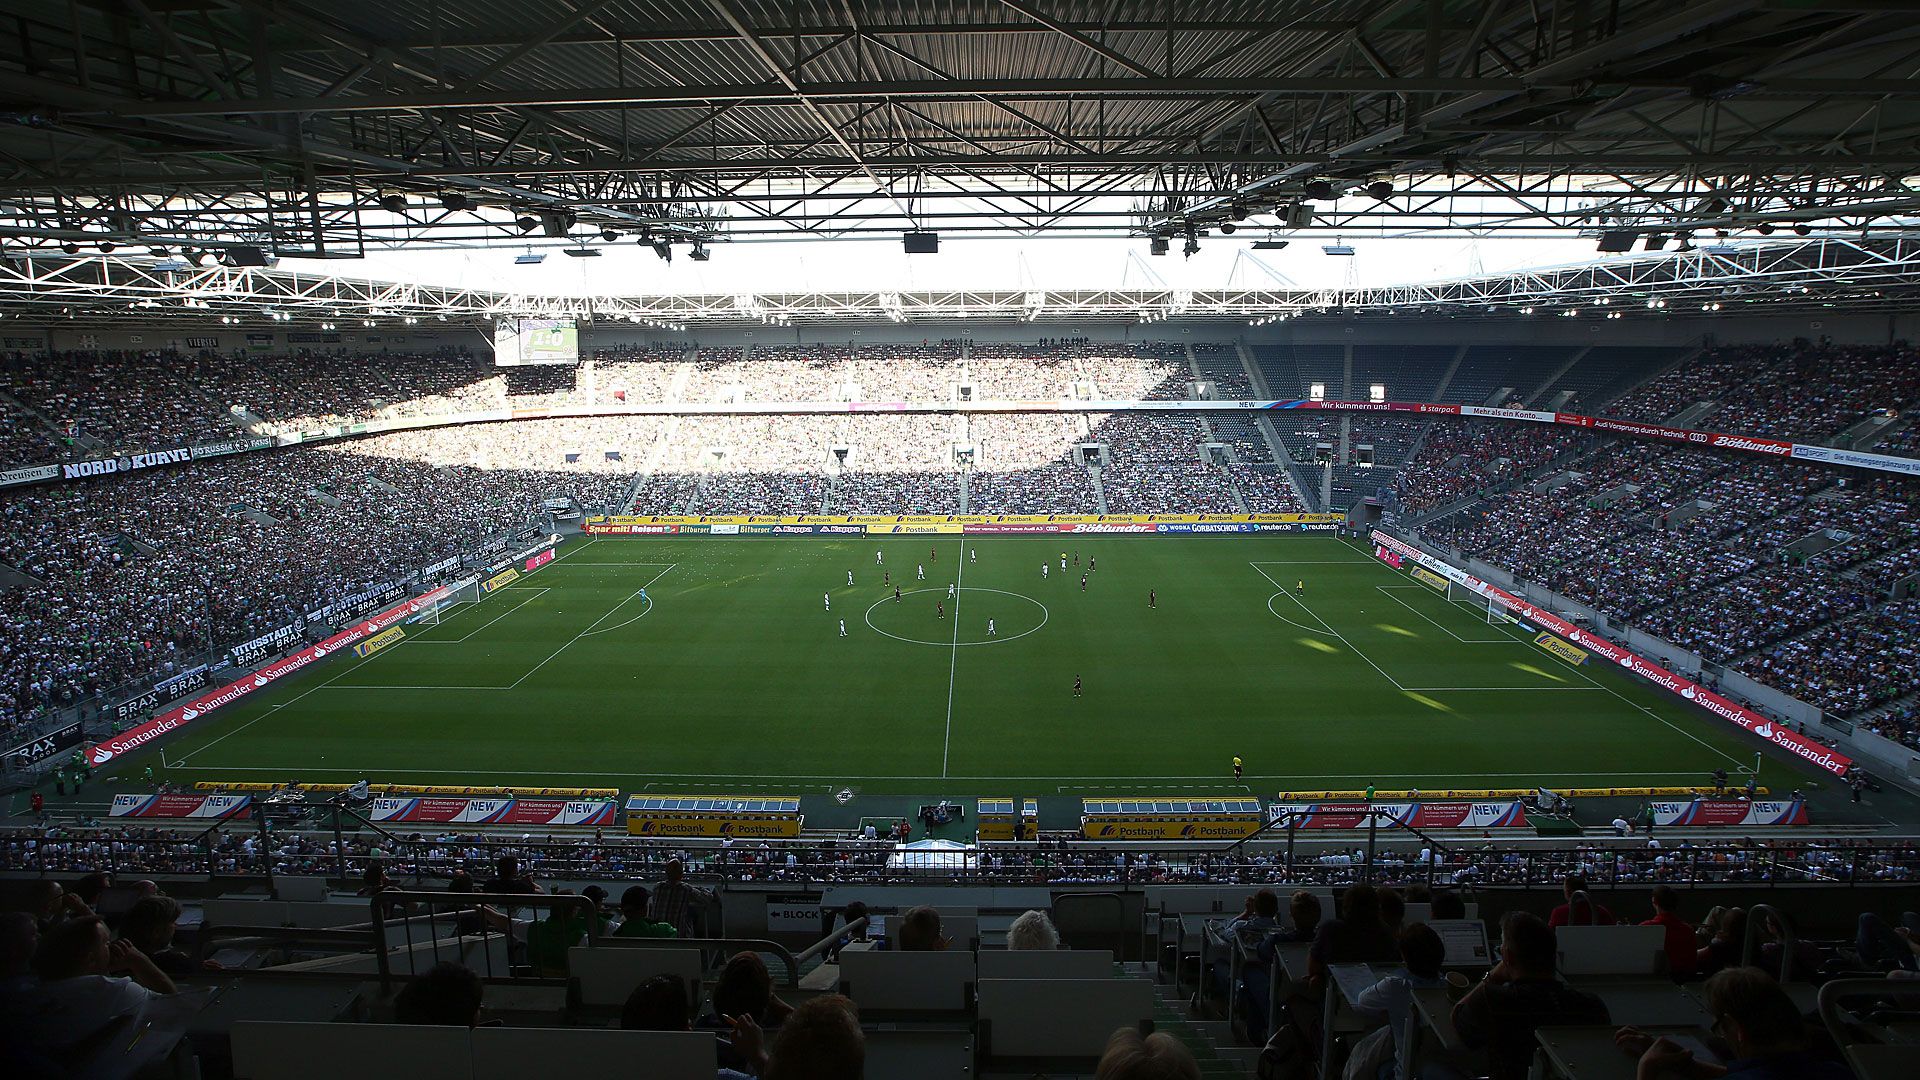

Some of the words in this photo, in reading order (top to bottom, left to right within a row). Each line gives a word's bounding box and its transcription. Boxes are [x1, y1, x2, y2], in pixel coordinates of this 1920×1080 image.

[1239, 401, 1256, 409] NEW
[1335, 402, 1371, 410] kümmern
[1373, 403, 1391, 411] uns!
[1473, 407, 1491, 416] Mehr
[1491, 409, 1501, 417] als
[1502, 410, 1514, 418] ein
[1594, 420, 1608, 429] Audi
[1609, 422, 1640, 434] Vorsprung
[1640, 426, 1660, 436] durch
[1660, 429, 1687, 440] Technik
[193, 444, 233, 456] BORUSSIA
[250, 439, 270, 450] FANS
[1714, 436, 1791, 455] Böklunder
[1834, 453, 1844, 461] Die
[62, 458, 117, 479] NORD
[131, 448, 191, 471] KURVE
[1258, 514, 1282, 522] Postbank
[1308, 514, 1333, 522] Postbank
[631, 525, 663, 533] Reisen
[680, 525, 710, 534] Bitburger
[739, 525, 770, 534] Bitburger
[782, 525, 812, 534] Kappa
[830, 525, 861, 534] Kappa
[1072, 524, 1148, 533] Böklunder
[1191, 524, 1239, 533] GORBATSCHOW
[1422, 571, 1445, 588] Postbank
[384, 585, 405, 600] BRAX
[358, 596, 379, 613] BRAX
[1494, 591, 1524, 614] Santander
[327, 608, 351, 627] BRAX
[376, 608, 412, 630] Santander
[1530, 611, 1565, 634] Santander
[231, 622, 293, 658] VITUSSTADT
[276, 630, 303, 648] BRAX
[322, 629, 364, 655] Santander
[371, 629, 403, 649] Postbank
[1549, 641, 1581, 664] Postbank
[1578, 633, 1620, 662] Santander
[237, 646, 267, 665] BRAX
[264, 653, 313, 684] Santander
[1631, 660, 1680, 692] Santander
[169, 672, 205, 696] BRAX
[195, 681, 252, 714] Santander
[118, 693, 160, 718] BRAX
[1694, 691, 1753, 728] Santander
[111, 716, 178, 757] Santander
[1771, 729, 1844, 774] Santander
[114, 796, 139, 806] NEW
[207, 796, 232, 807] NEW
[374, 800, 400, 810] NEW
[470, 801, 495, 811] NEW
[567, 803, 592, 813] NEW
[1270, 806, 1296, 818] NEW
[1372, 806, 1399, 817] NEW
[1474, 805, 1500, 816] NEW
[1654, 803, 1680, 814] NEW
[1753, 802, 1780, 813] NEW
[660, 822, 705, 833] Postbank
[738, 824, 783, 834] Postbank
[1120, 826, 1166, 836] Postbank
[1200, 826, 1246, 836] Postbank
[784, 910, 818, 919] BLOCK
